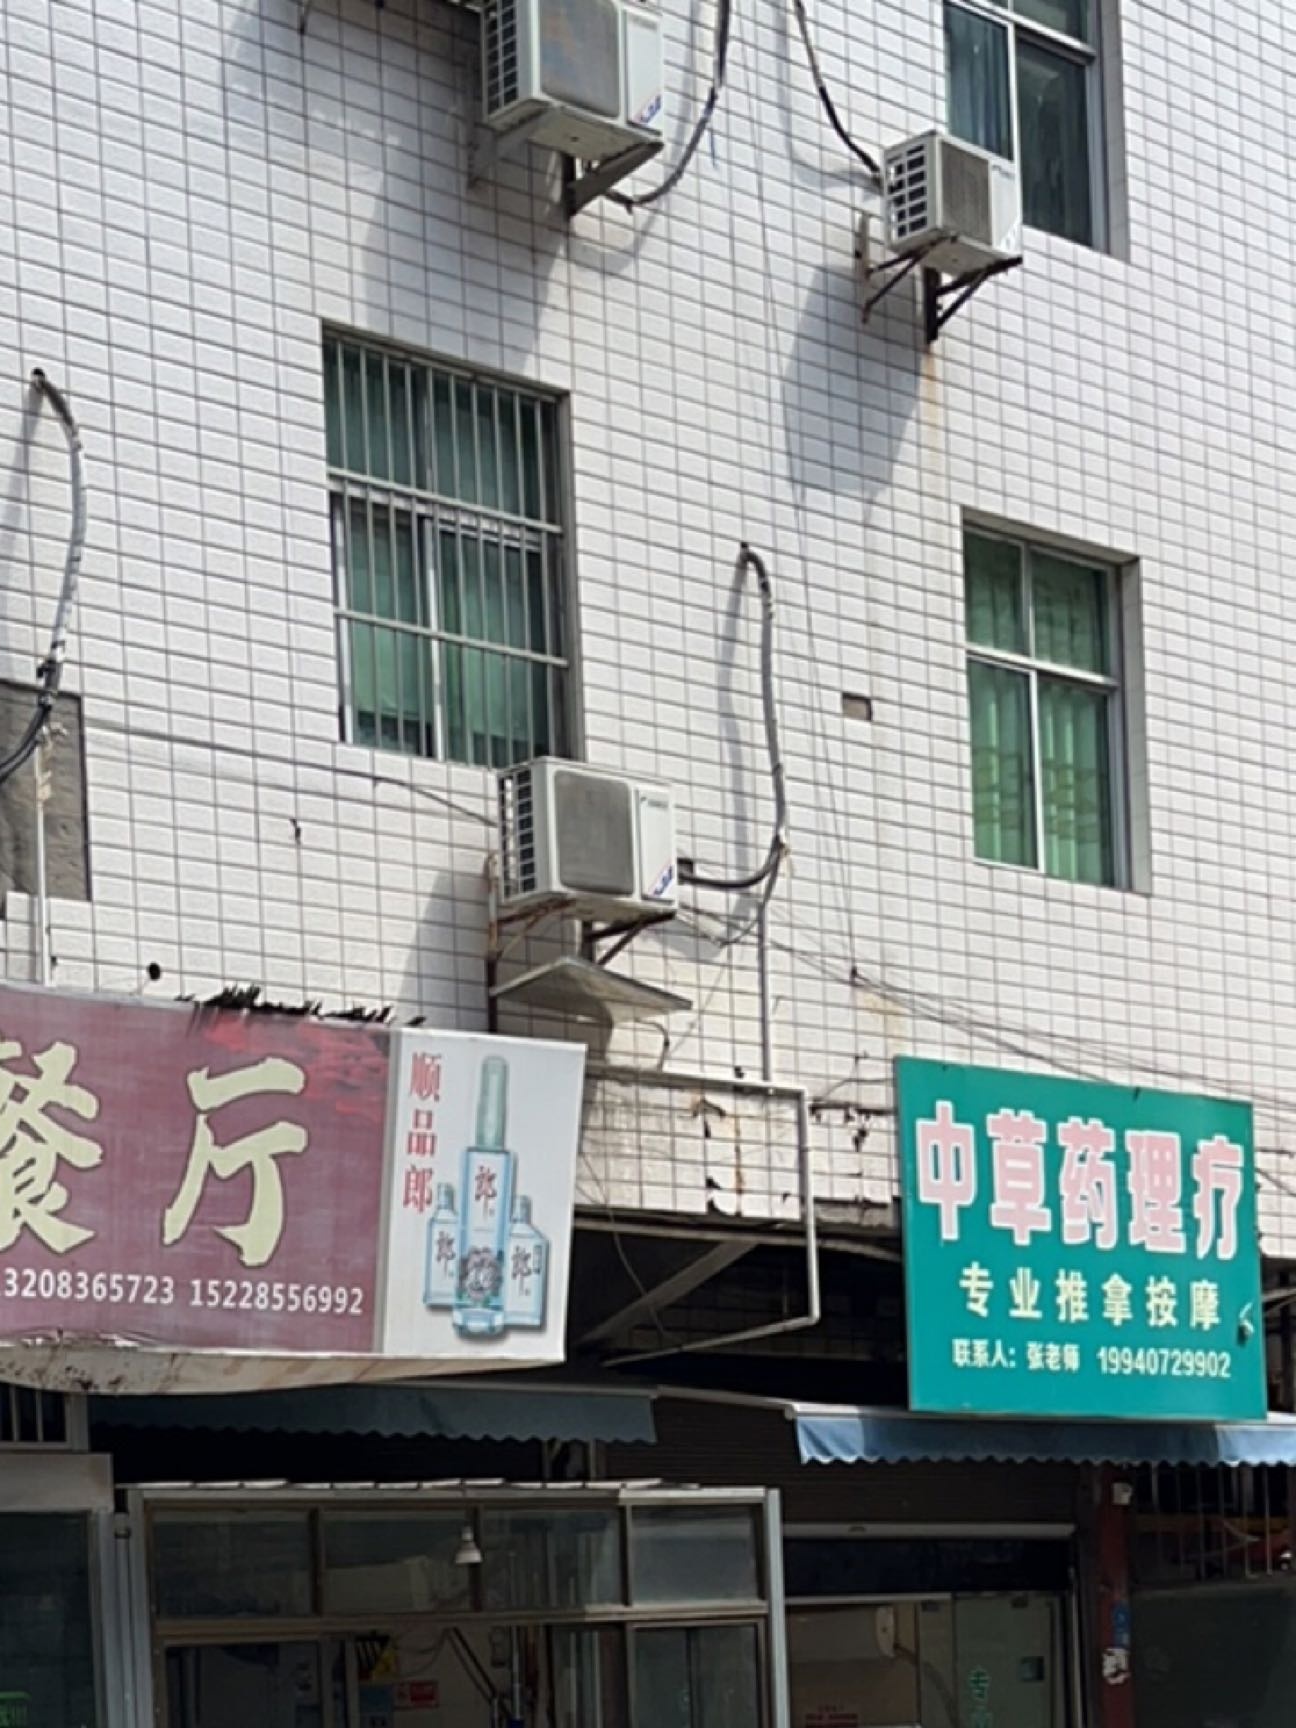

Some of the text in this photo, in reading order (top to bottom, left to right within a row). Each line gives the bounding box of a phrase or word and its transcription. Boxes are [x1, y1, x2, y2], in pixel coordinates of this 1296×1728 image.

[403, 1051, 442, 1214] 顺品郎
[915, 1099, 1245, 1260] 中草药理疗
[189, 1278, 364, 1316] 15228556992
[958, 1261, 1221, 1331] 专业推拿按摩
[1096, 1346, 1232, 1379] 19940729902
